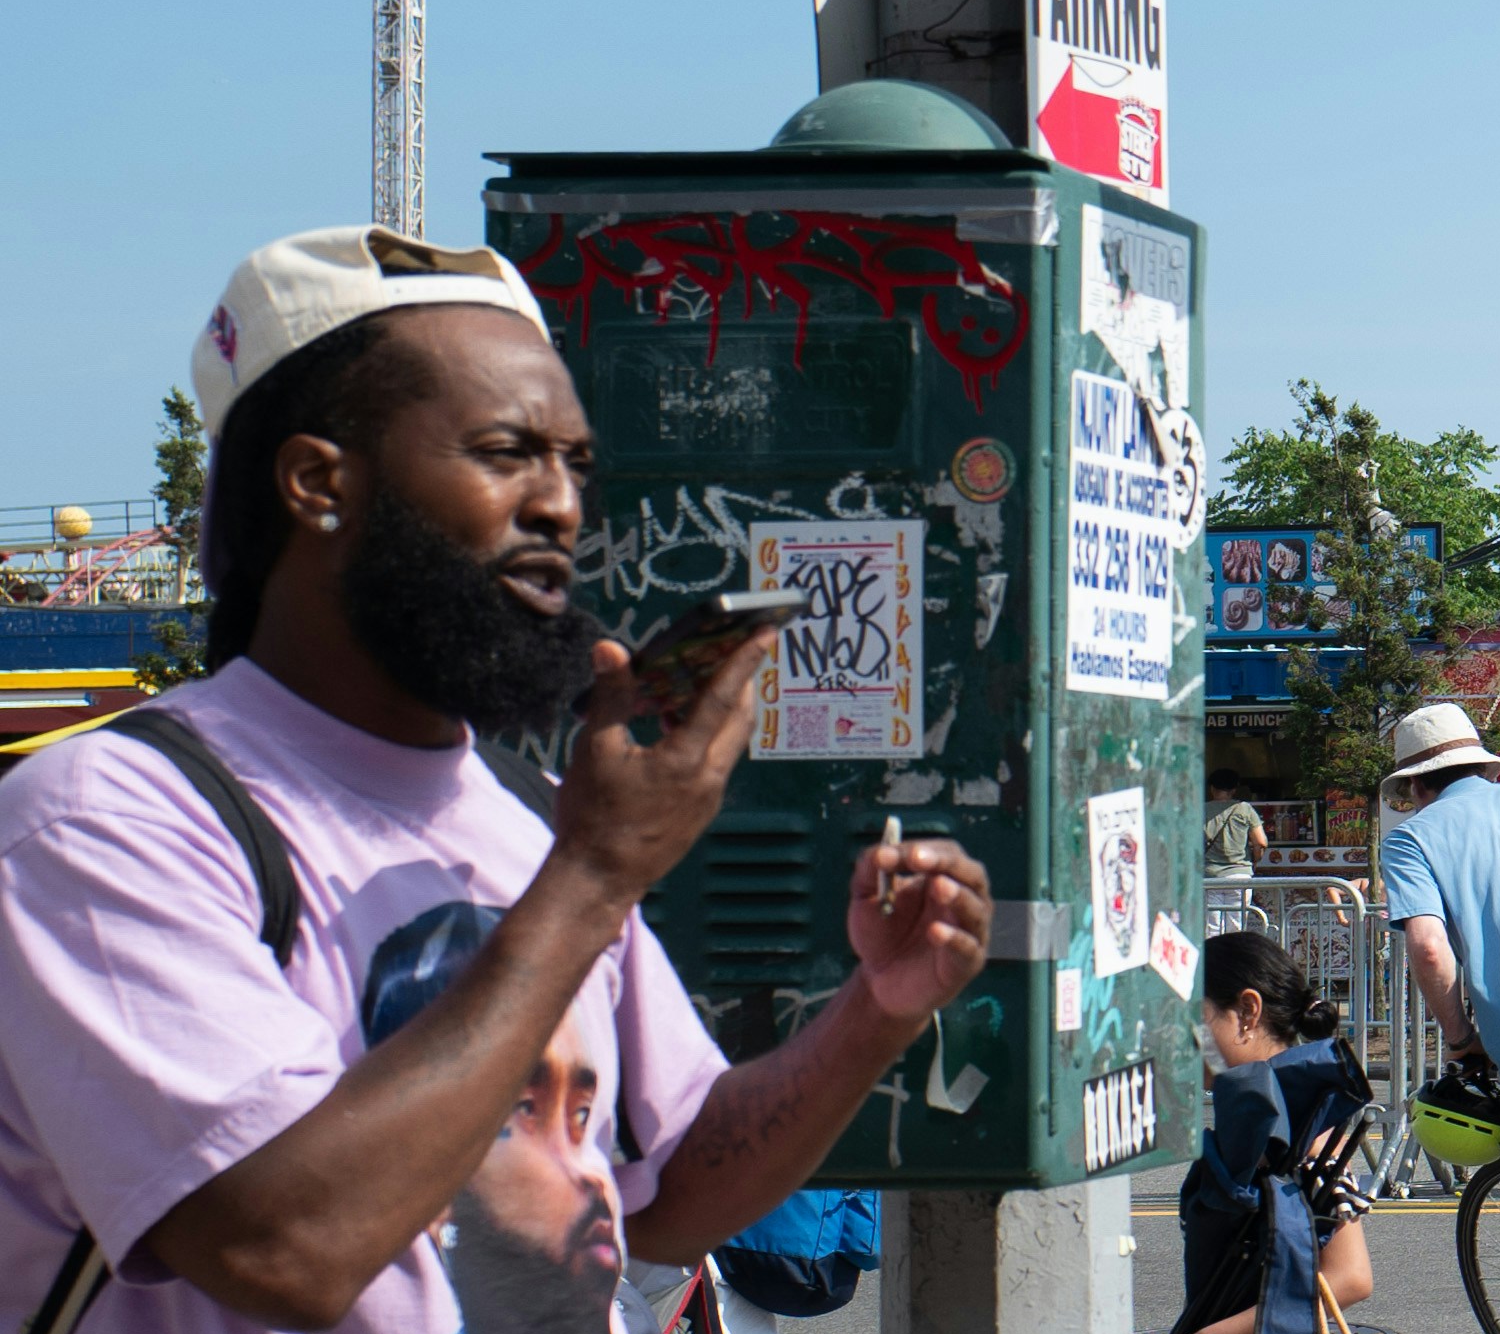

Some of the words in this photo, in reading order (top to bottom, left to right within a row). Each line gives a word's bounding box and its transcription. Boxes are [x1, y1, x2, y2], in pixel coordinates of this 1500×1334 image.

[1073, 519, 1099, 589] 332
[1109, 609, 1147, 644] HOURS
[1071, 641, 1123, 679] Hablamos
[1232, 714, 1288, 727] (PINCH
